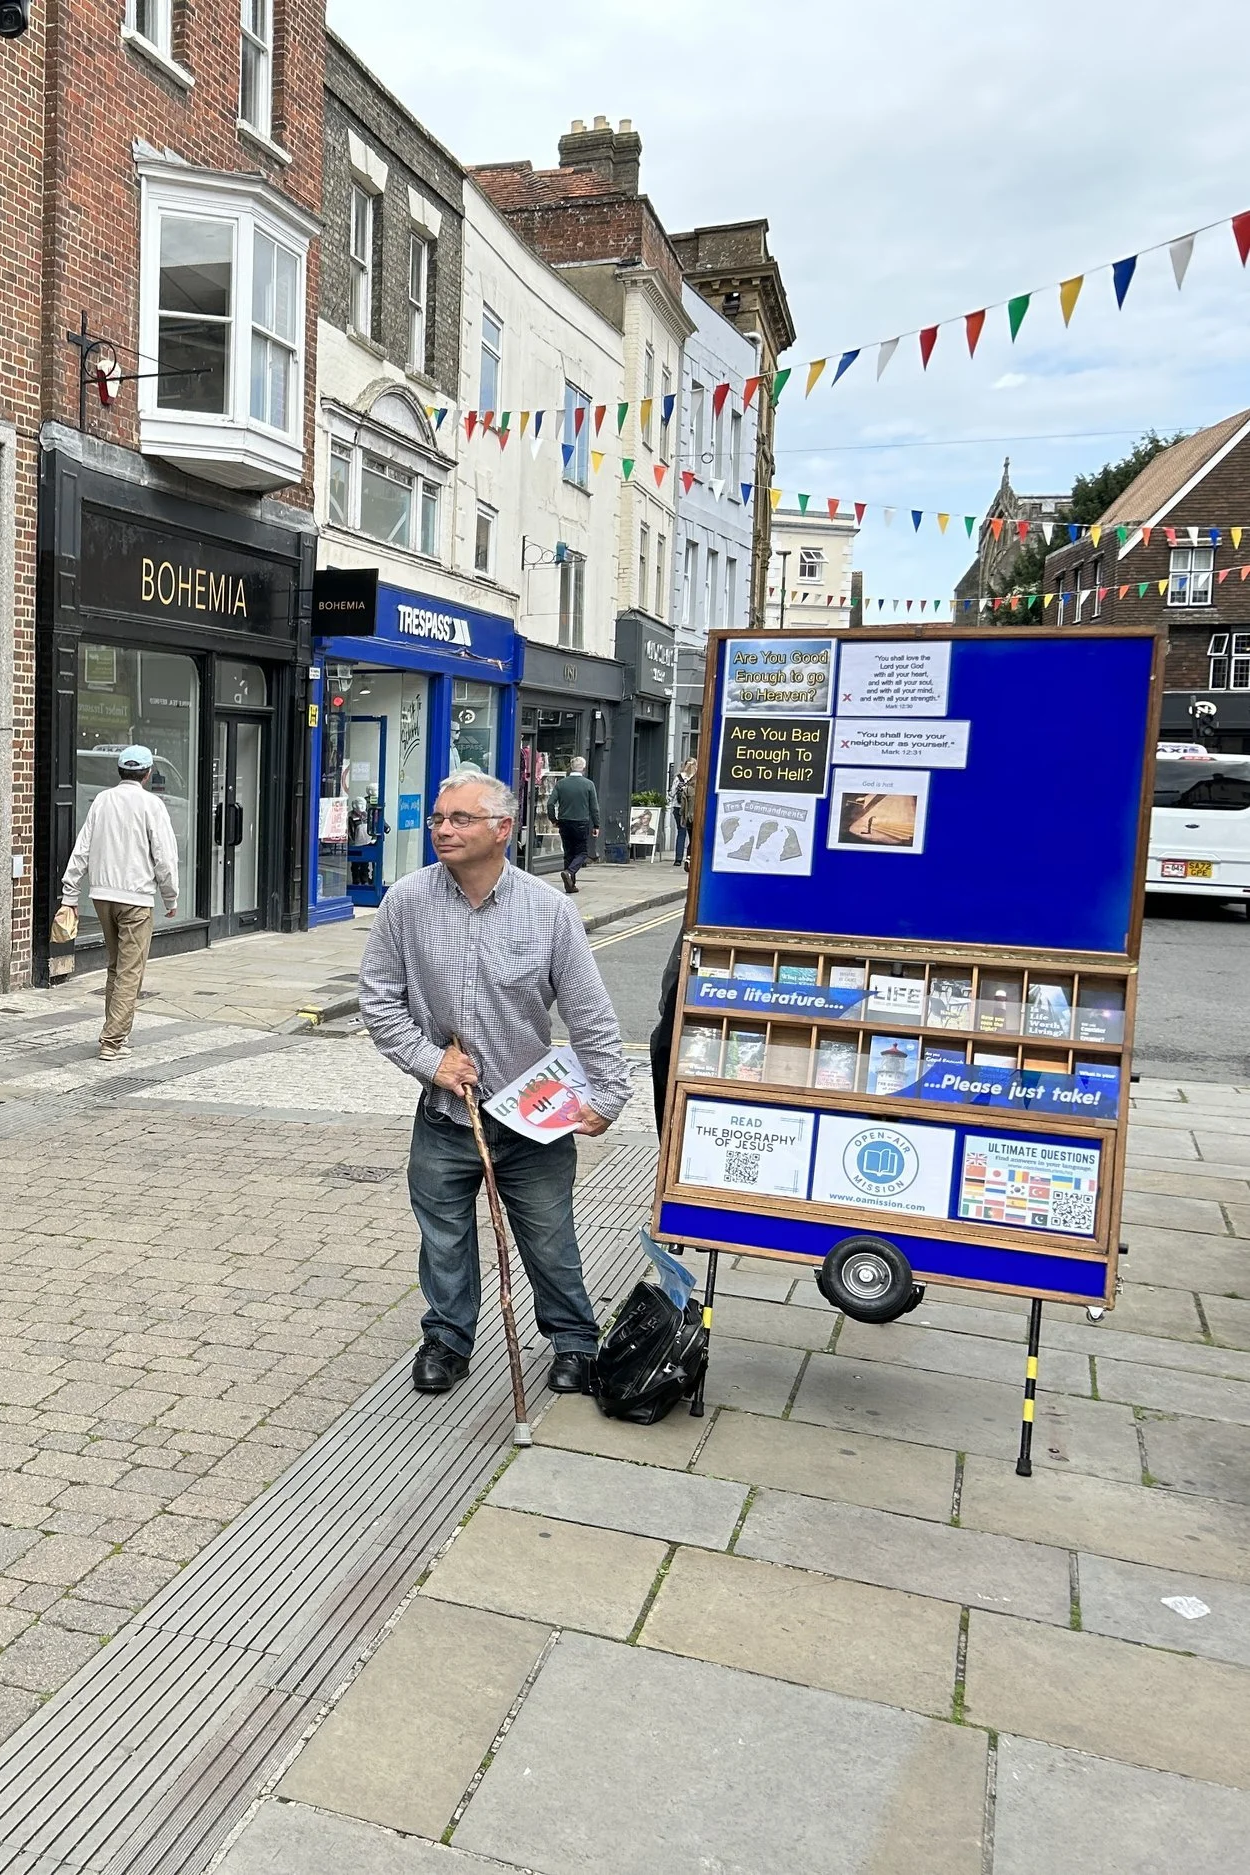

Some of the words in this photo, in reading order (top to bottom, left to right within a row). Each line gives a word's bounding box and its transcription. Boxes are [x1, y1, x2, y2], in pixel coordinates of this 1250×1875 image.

[141, 557, 247, 618] BOHEMIA
[318, 601, 365, 610] BOHEMIA
[397, 604, 452, 642] TRESPASS
[733, 651, 758, 664] Are
[760, 651, 786, 664] You
[790, 650, 828, 664] Good
[735, 669, 786, 686] Enough
[790, 670, 804, 683] to
[807, 672, 825, 686] go
[740, 688, 753, 701] to
[756, 688, 817, 702] Heaven?
[731, 726, 756, 740] Are
[761, 727, 787, 741] You
[791, 728, 820, 742] Bad
[736, 746, 790, 764] Enough
[795, 748, 812, 762] To
[731, 765, 753, 779] Go
[756, 766, 773, 780] To
[777, 767, 813, 781] Hell?
[1189, 862, 1211, 870] SA72
[700, 983, 738, 1000] Free
[744, 987, 844, 1009] literature....
[874, 985, 921, 1003] LIFE
[1029, 1027, 1064, 1037] Living?
[1030, 1021, 1060, 1030] Worth
[494, 1058, 570, 1117] Heaven
[924, 1074, 1002, 1095] ...Please
[1008, 1082, 1046, 1100] just
[1052, 1087, 1101, 1105] take!
[730, 1116, 763, 1128] READ
[696, 1125, 718, 1137] THE
[721, 1128, 796, 1145] BIOGRAPHY
[854, 1132, 911, 1153] OPEN-AIR
[715, 1137, 731, 1147] OF
[735, 1140, 774, 1152] JESUS
[988, 1142, 1038, 1158] ULTIMATE
[1040, 1148, 1096, 1165] QUESTIONS
[1011, 1157, 1036, 1165] answers
[853, 1175, 904, 1193] MISSION
[829, 1193, 925, 1211] www.oamission.com
